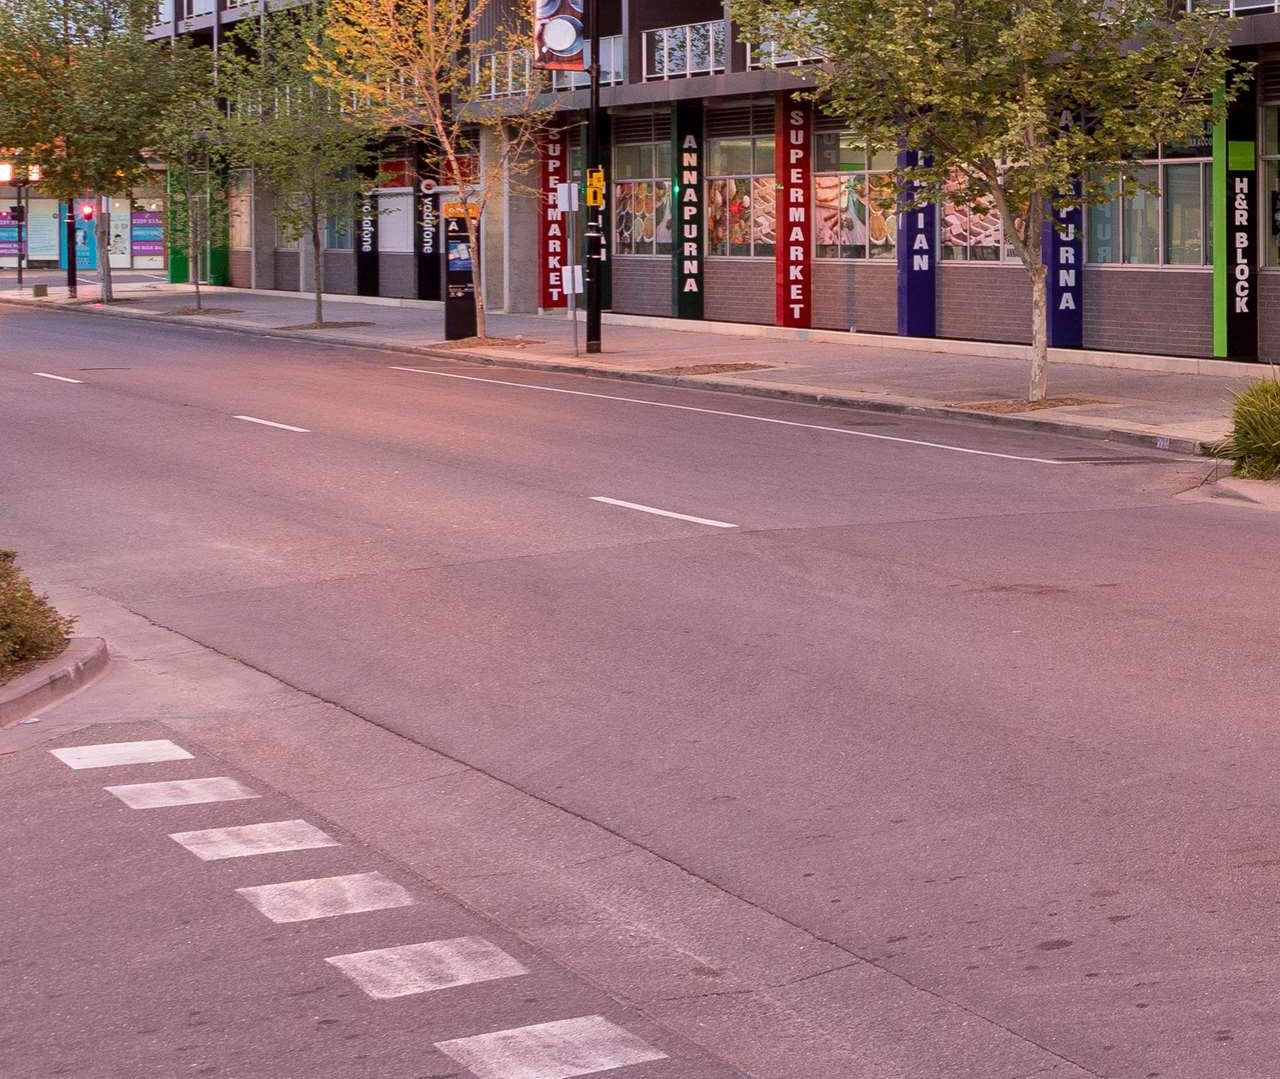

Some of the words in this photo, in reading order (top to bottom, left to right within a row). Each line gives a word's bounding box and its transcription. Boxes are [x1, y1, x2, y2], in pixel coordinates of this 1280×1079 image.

[361, 199, 375, 253] voafone
[423, 197, 436, 254] vodafone
[683, 134, 699, 293] ANNAPURNA
[789, 109, 805, 319] SUPERMARKET
[912, 150, 929, 271] IIAN
[1058, 109, 1077, 310] APURNA
[1235, 177, 1249, 226] H&R
[1235, 232, 1249, 313] BLOCK
